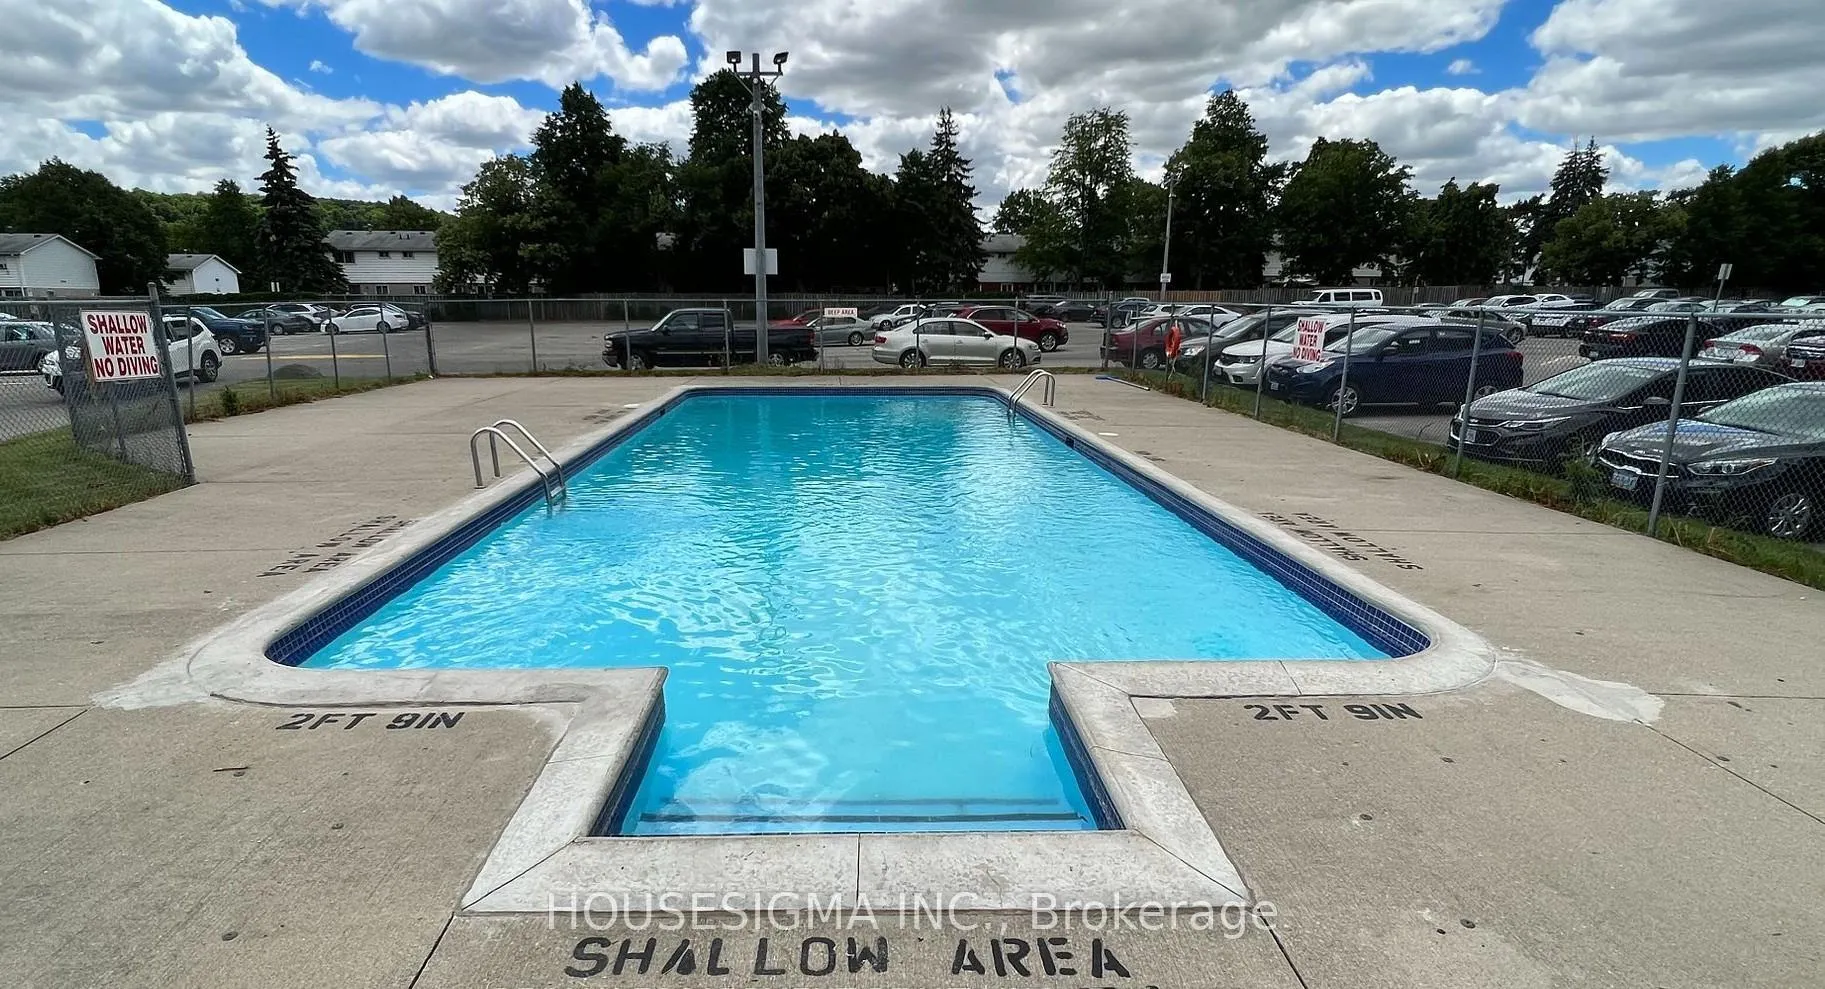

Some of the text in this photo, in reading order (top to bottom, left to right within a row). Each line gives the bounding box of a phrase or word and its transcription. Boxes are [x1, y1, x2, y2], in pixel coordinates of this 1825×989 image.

[86, 314, 148, 334] SHALLOW
[1297, 319, 1325, 334] SHALLOW
[101, 336, 146, 355] WATER
[1300, 334, 1318, 347] WATER
[1293, 346, 1321, 361] NO DIVING
[94, 356, 158, 377] NO DIVING
[275, 711, 465, 730] 2FT 9IN
[1243, 703, 1424, 720] 2FT 9IN
[564, 936, 1131, 978] SHALLOW AREA
